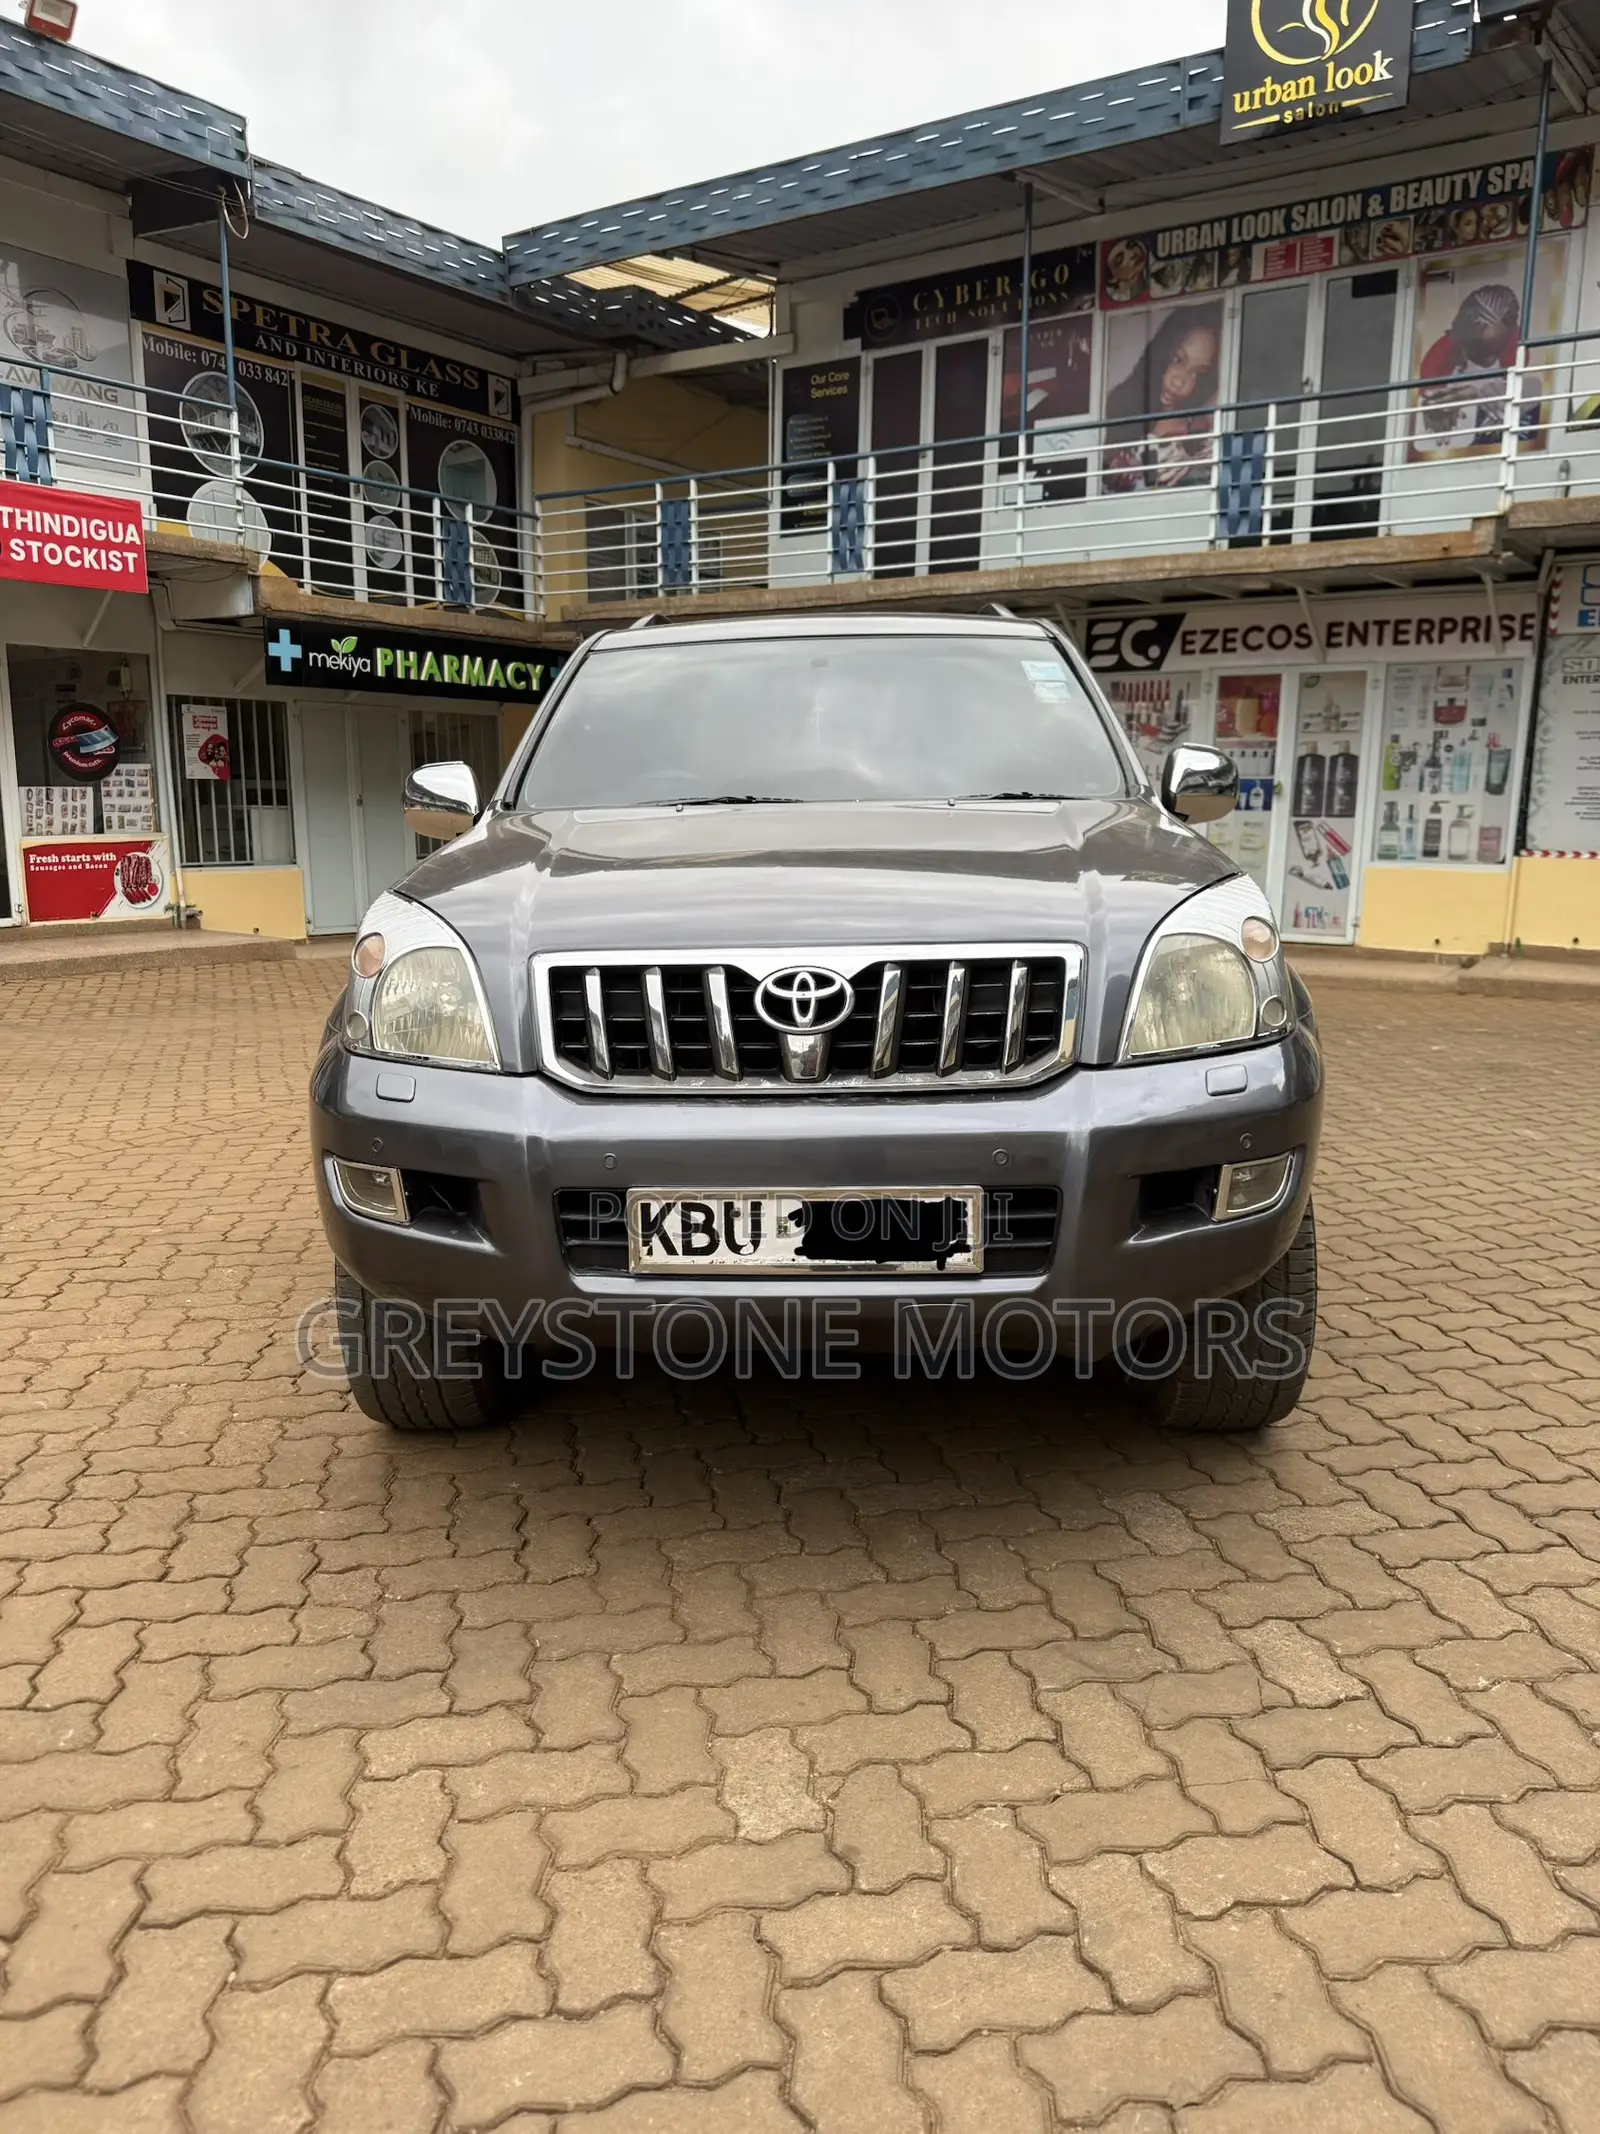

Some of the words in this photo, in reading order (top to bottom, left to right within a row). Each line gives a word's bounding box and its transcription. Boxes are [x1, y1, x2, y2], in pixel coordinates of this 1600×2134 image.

[1233, 76, 1316, 113] urban
[1324, 50, 1393, 92] look
[1284, 101, 1340, 123] salon
[1157, 219, 1228, 258] URBAN
[1231, 207, 1288, 243] LOOK
[1290, 194, 1363, 232] SALON
[1367, 193, 1385, 217] &
[1390, 169, 1484, 213] BEAUTY
[1487, 160, 1535, 196] SPA
[202, 288, 361, 357] SPETRA
[370, 341, 481, 391] GLASS
[142, 335, 197, 364] Mobile:
[201, 350, 229, 371] 074
[238, 361, 262, 381] 033
[265, 367, 288, 387] 842
[256, 334, 298, 357] AND
[305, 346, 411, 390] INTERIORS
[416, 380, 440, 398] KE
[810, 373, 827, 386] Our
[828, 371, 850, 383] Core
[810, 385, 848, 399] Services
[410, 406, 452, 430] Mobile:
[454, 419, 479, 437] 0743
[0, 505, 141, 545] THINDIGUA
[9, 538, 139, 573] STOCKIST
[1180, 622, 1313, 656] EZECOS
[1325, 612, 1536, 649] ENTERPRISE
[308, 649, 371, 678] mekiya
[375, 647, 545, 691] PHARMACY
[29, 853, 59, 864] Fresh
[61, 853, 91, 863] starts
[92, 851, 117, 862] with
[30, 864, 66, 872] Sausages
[640, 1201, 762, 1257] KBU
